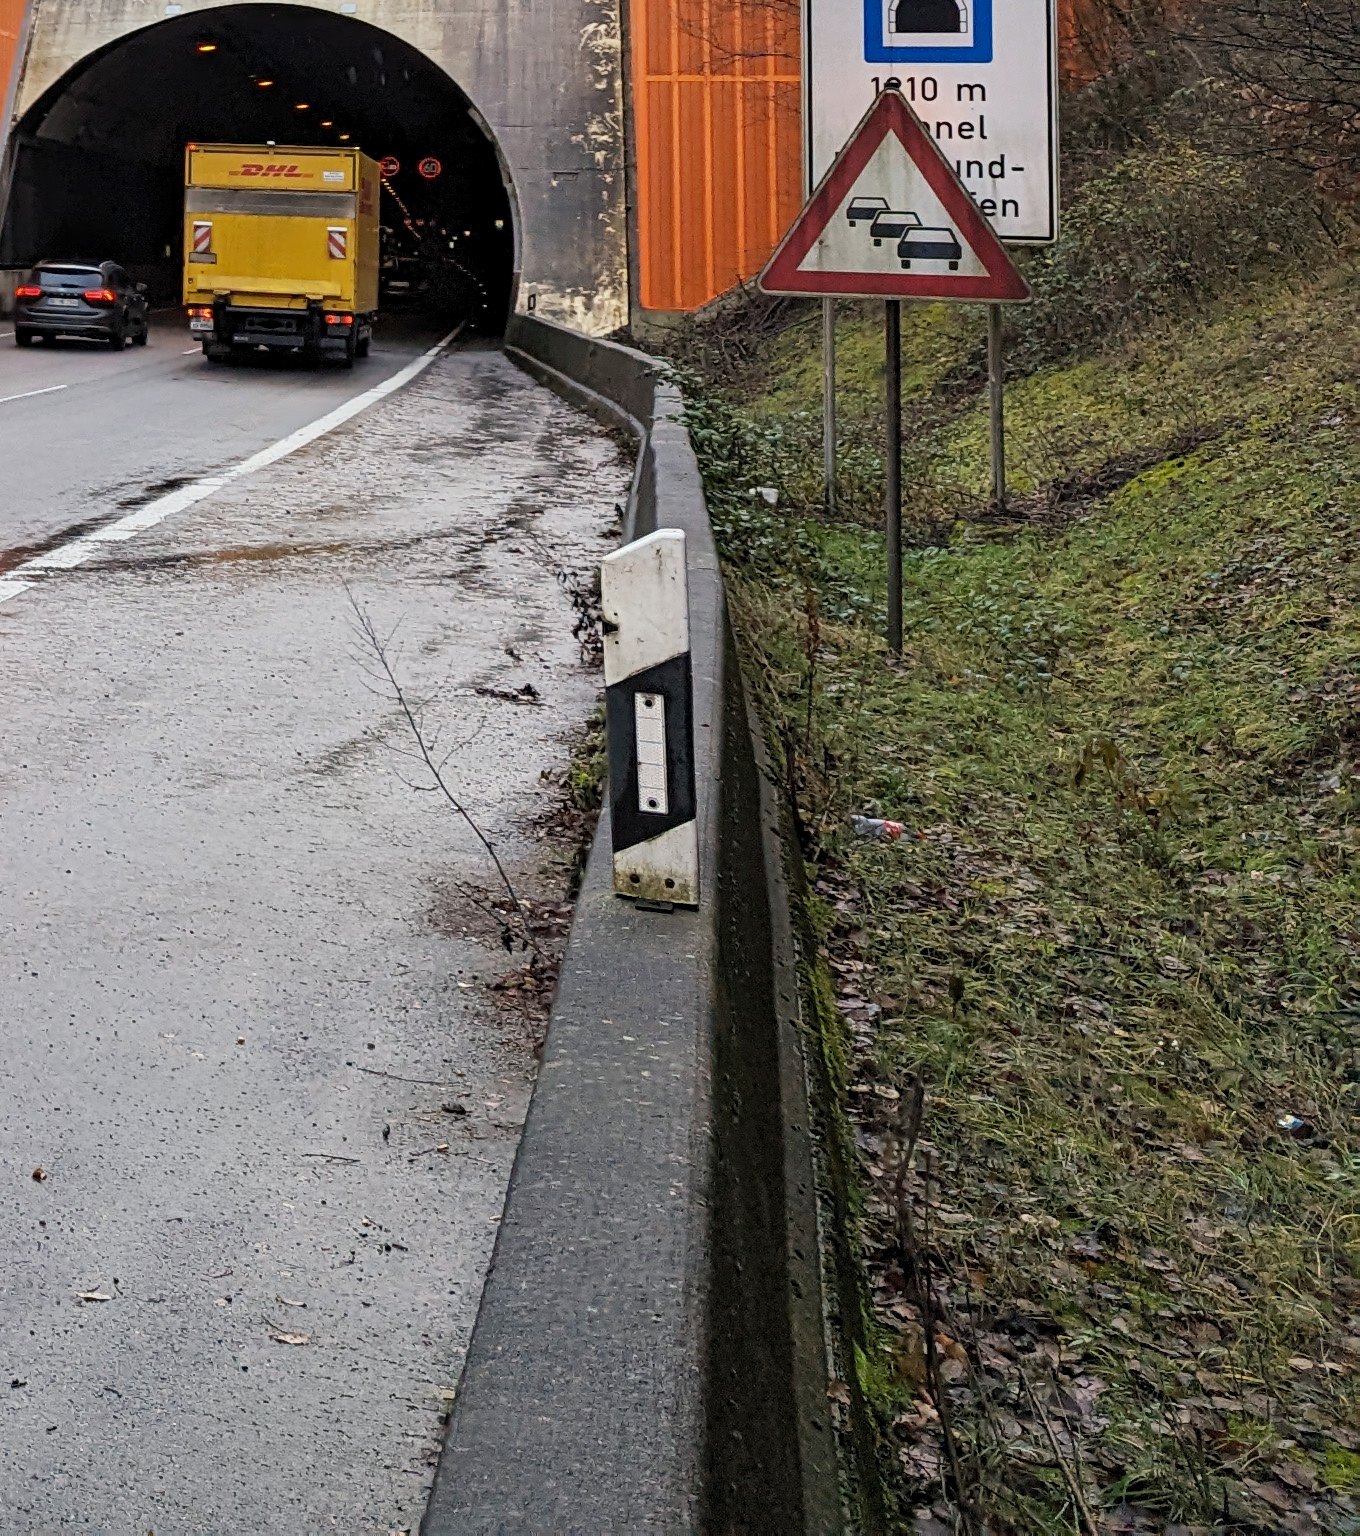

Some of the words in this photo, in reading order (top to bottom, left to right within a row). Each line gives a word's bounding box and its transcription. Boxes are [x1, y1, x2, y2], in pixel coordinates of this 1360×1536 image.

[956, 82, 987, 102] m
[921, 114, 988, 140] nel
[240, 163, 304, 178] DHL
